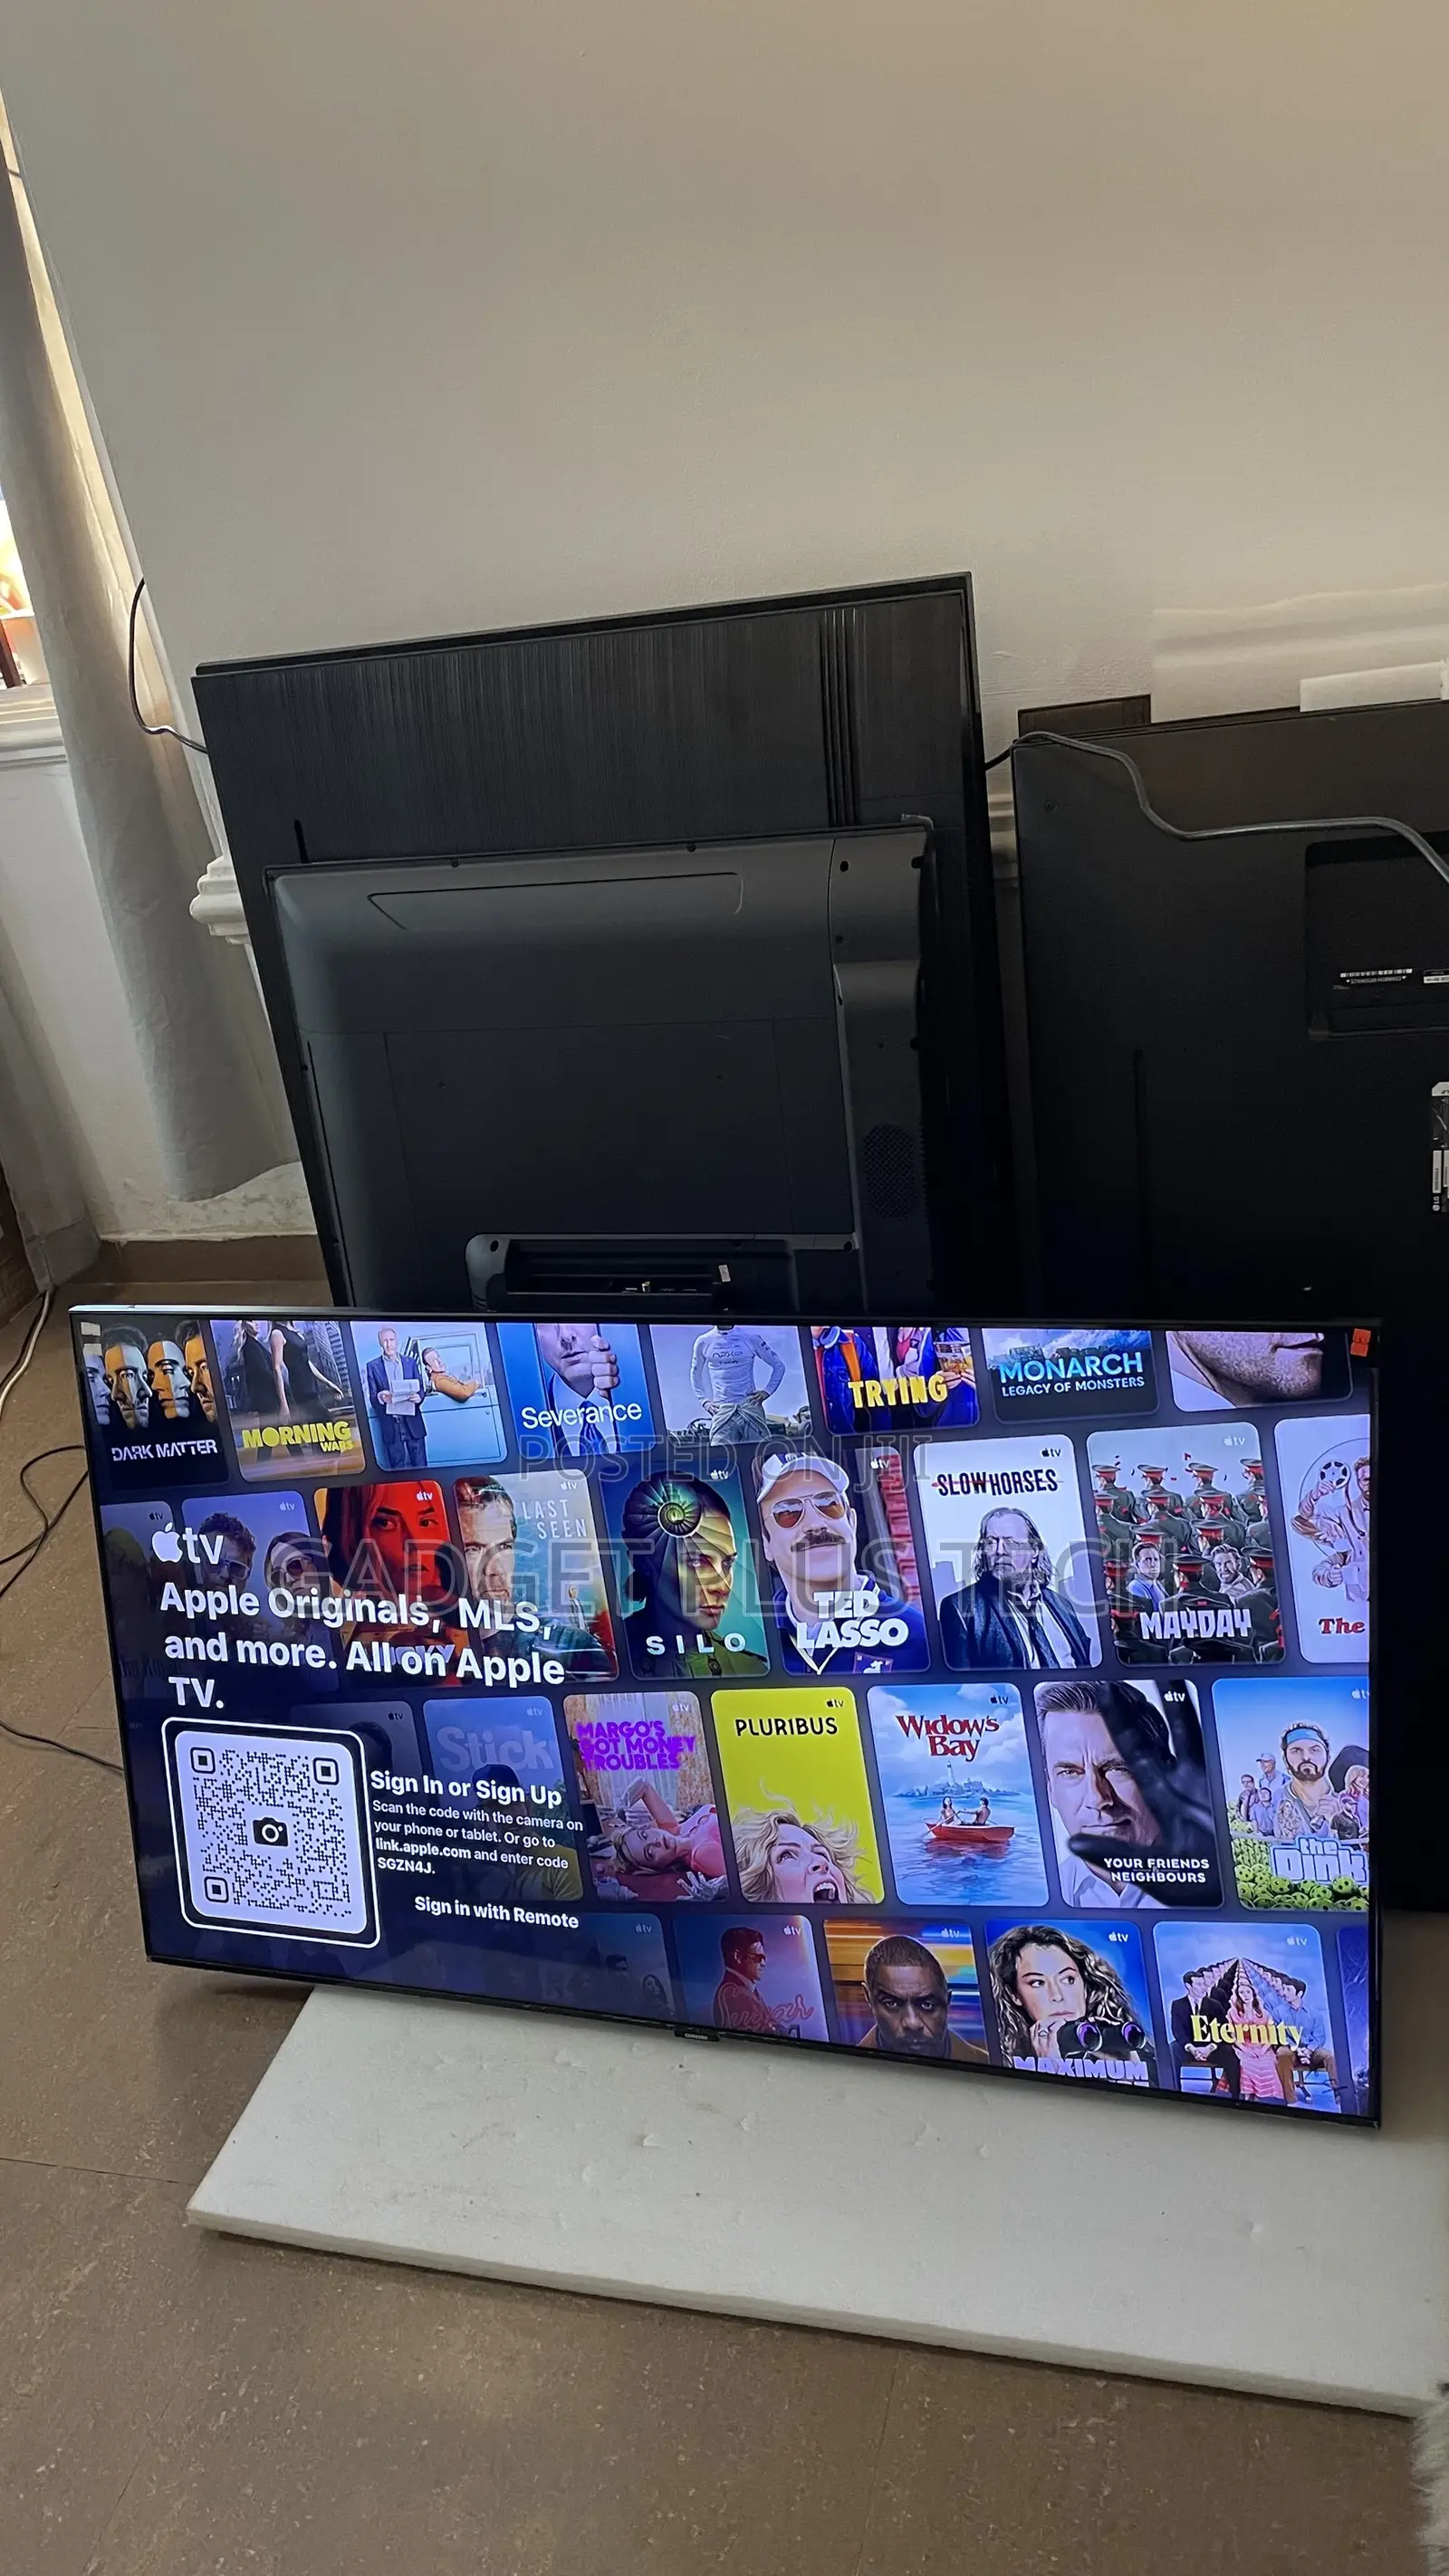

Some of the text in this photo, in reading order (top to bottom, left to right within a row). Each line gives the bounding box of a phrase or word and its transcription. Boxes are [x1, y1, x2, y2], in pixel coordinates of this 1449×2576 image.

[998, 1352, 1144, 1383] MONARCH
[848, 1374, 947, 1409] TRYING
[1002, 1376, 1146, 1397] LEGACY OF MONSTERS
[521, 1403, 642, 1430] Severance
[241, 1421, 351, 1449] MORNING
[111, 1439, 218, 1461] DARK MATTER
[936, 1468, 1059, 1497] SLOW HORSES
[522, 1499, 570, 1518] LAST
[537, 1518, 587, 1540] SEEN
[160, 1583, 552, 1640] Apple Originals, MLS,
[813, 1591, 881, 1619] TED
[796, 1620, 910, 1650] LASSO
[1139, 1608, 1252, 1639] MAYDAY
[1319, 1617, 1365, 1634] The
[647, 1633, 746, 1655] SILO
[165, 1633, 228, 1662] and
[237, 1640, 338, 1670] more.
[347, 1642, 392, 1673] All
[401, 1652, 446, 1677] on
[456, 1648, 566, 1688] Apple
[168, 1676, 225, 1709] TV.
[576, 1720, 666, 1738] MARGO'S
[438, 1727, 555, 1771] Stick
[626, 1736, 696, 1754] MONEY
[928, 1736, 981, 1762] Bay
[583, 1753, 681, 1771] TROUBLES
[370, 1770, 561, 1809] Sign In or Sign Up
[373, 1800, 583, 1831] Scan the code with the camera on
[374, 1822, 556, 1848] your phone or tablet. Or go to
[1298, 1837, 1339, 1855] the
[376, 1838, 569, 1869] link.apple.com and enter code
[378, 1857, 436, 1874] SGZN4J.
[1104, 1858, 1210, 1869] YOUR FRIENDS
[1111, 1872, 1206, 1883] NEIGHBOURS
[414, 1896, 579, 1929] Sign in with Remote
[1191, 2015, 1304, 2048] Eternity
[1013, 2056, 1149, 2081] MAXIMUM
